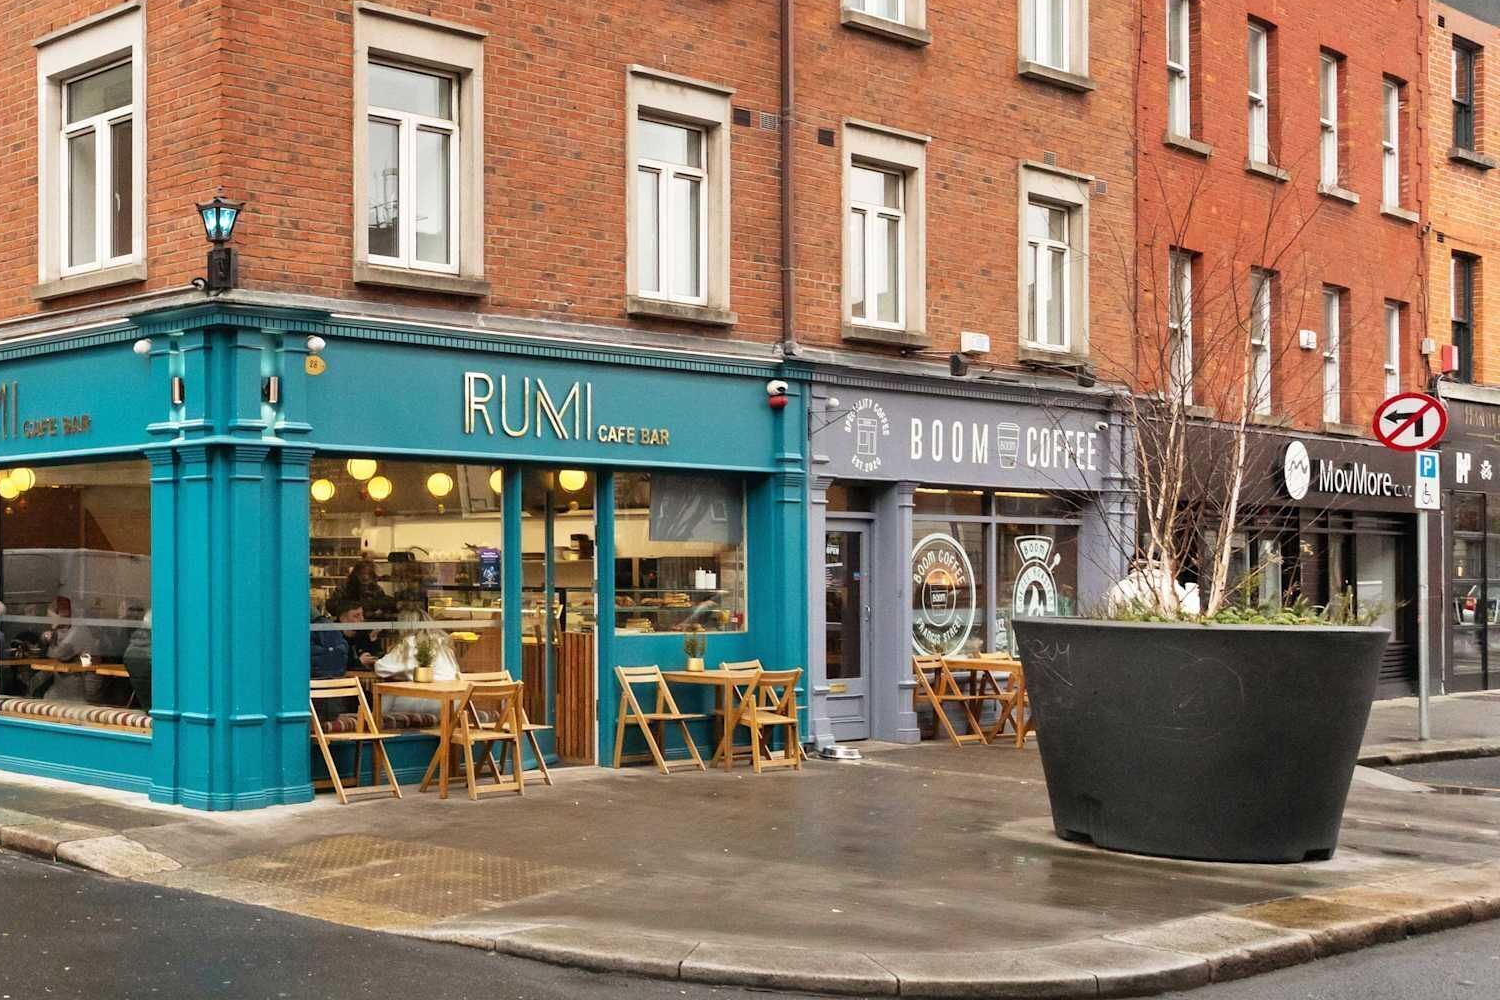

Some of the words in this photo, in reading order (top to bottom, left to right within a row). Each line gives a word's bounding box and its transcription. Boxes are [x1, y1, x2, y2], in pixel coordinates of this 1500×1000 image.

[464, 371, 592, 441] RUMI
[597, 424, 636, 444] CAFE
[640, 427, 670, 445] BAR
[23, 417, 58, 439] CAFE
[62, 415, 92, 435] BAR
[910, 417, 989, 464] BOOM
[1026, 426, 1097, 471] COFFEE
[1319, 459, 1392, 496] MovMore
[1424, 457, 1432, 475] P
[1023, 542, 1046, 557] BOOM
[913, 550, 936, 585] BOOM
[938, 549, 966, 585] COFFEE
[932, 593, 946, 603] BOOM
[942, 614, 964, 642] STREET
